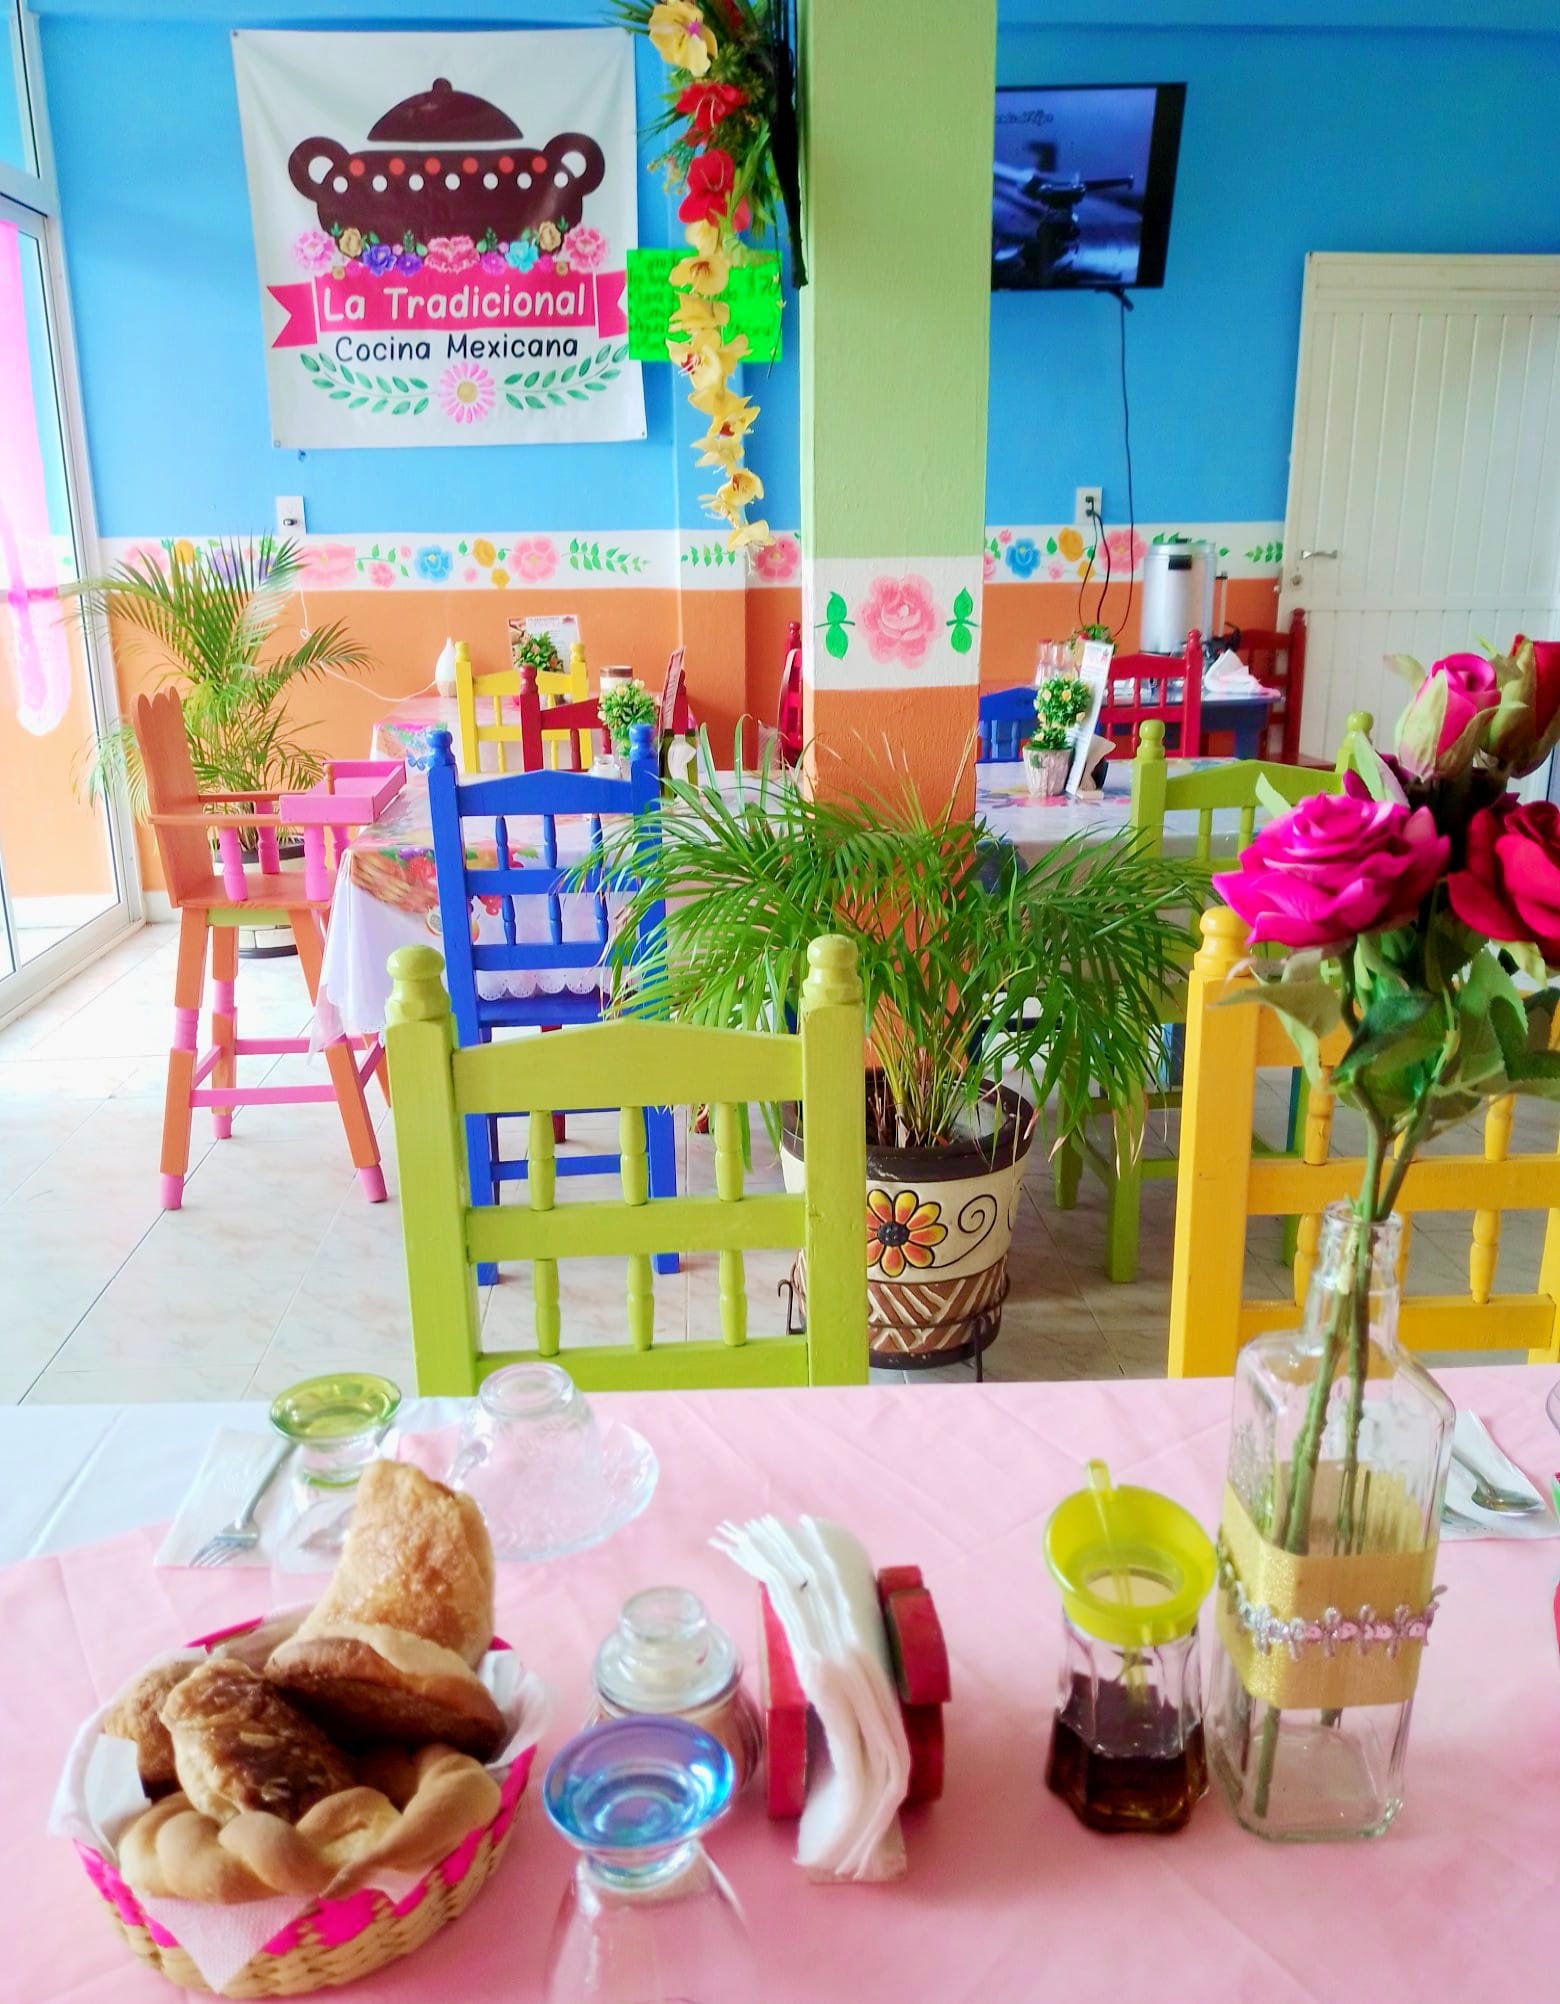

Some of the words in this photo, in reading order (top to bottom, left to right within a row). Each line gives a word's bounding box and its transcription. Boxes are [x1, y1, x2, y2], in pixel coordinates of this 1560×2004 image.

[323, 287, 366, 322] La
[383, 283, 586, 321] Tradicional
[335, 336, 431, 362] Cocina
[447, 332, 579, 360] Mexicana
